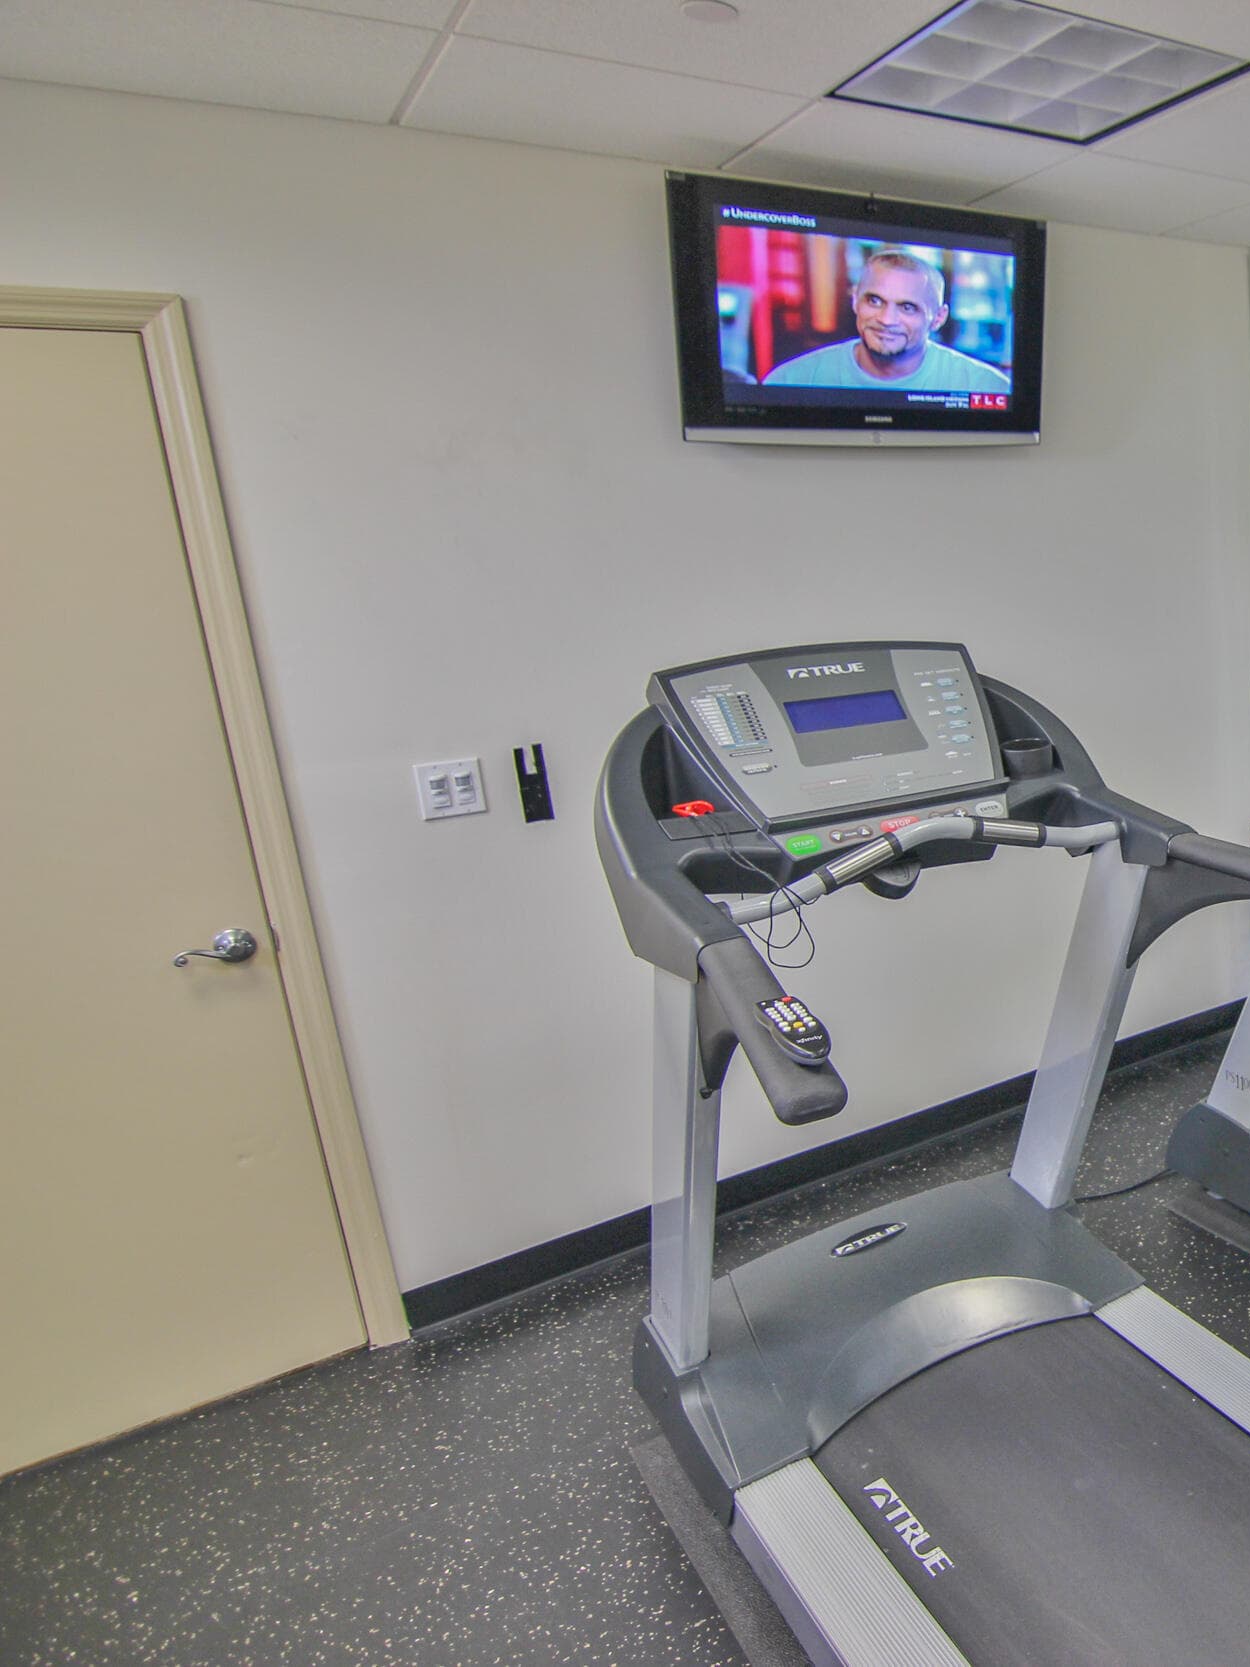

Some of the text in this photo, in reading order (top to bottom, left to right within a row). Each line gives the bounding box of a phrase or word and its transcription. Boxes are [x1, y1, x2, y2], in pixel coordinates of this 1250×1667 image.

[972, 394, 1006, 406] TLC
[807, 662, 866, 677] TRUE
[851, 1224, 901, 1248] TRUE
[885, 1498, 955, 1577] TRUE
